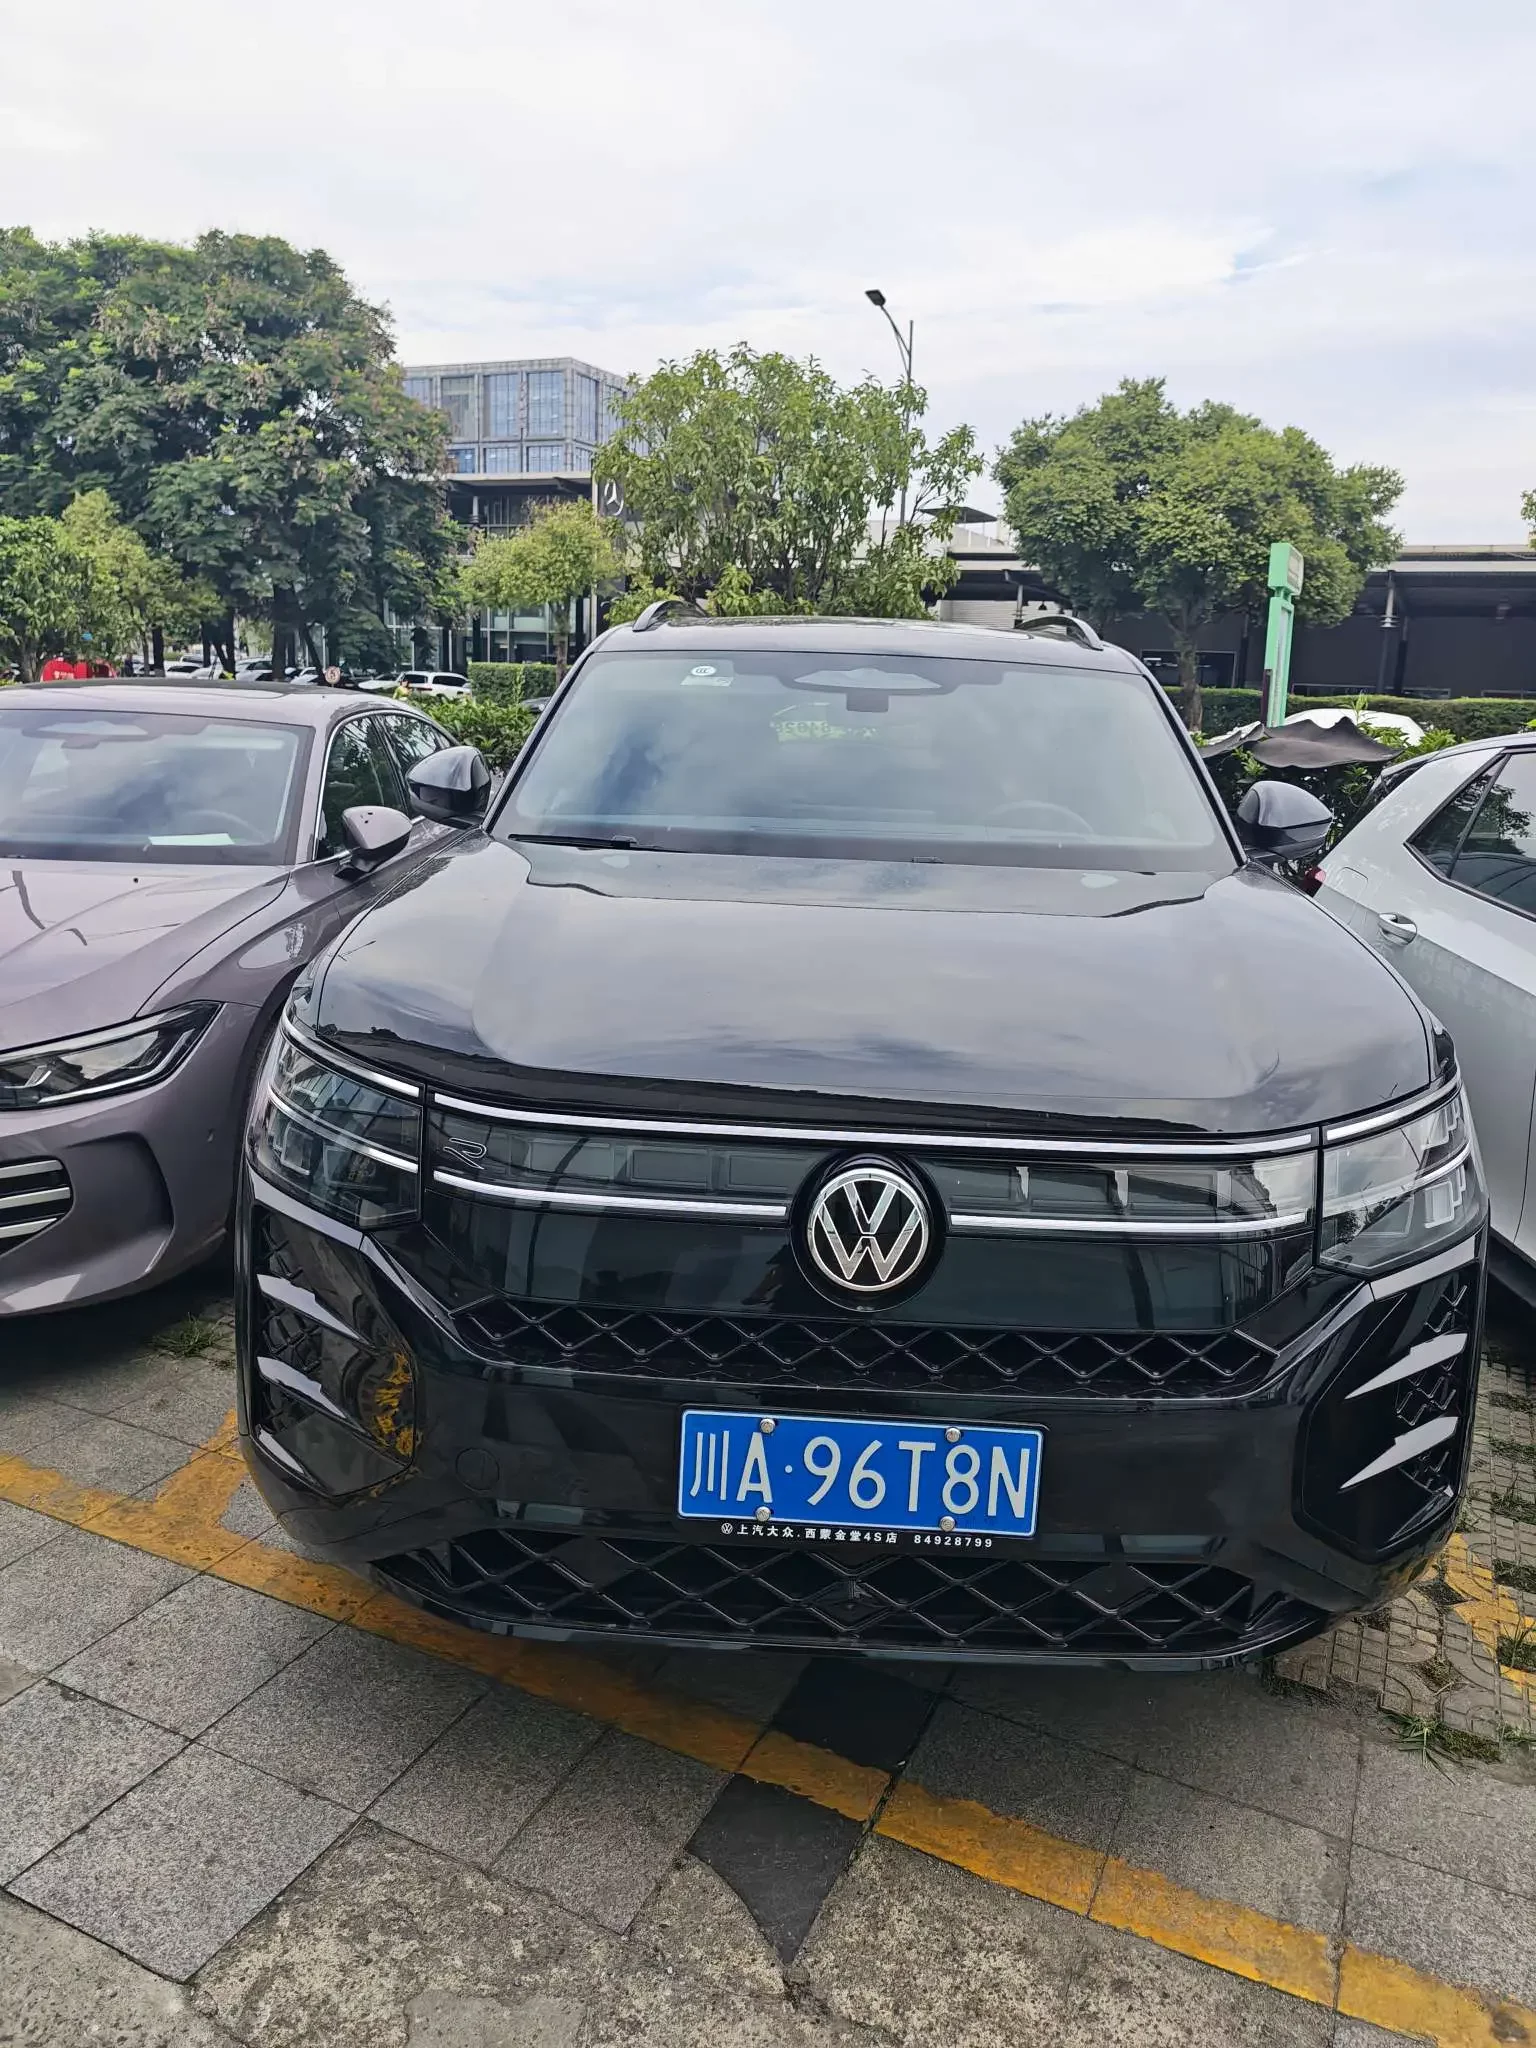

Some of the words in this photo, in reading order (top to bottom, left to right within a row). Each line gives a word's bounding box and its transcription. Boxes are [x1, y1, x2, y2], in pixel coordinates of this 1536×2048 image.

[816, 1180, 922, 1282] VW
[689, 1430, 1031, 1518] 川A·96T8N
[913, 1534, 993, 1548] 84928799
